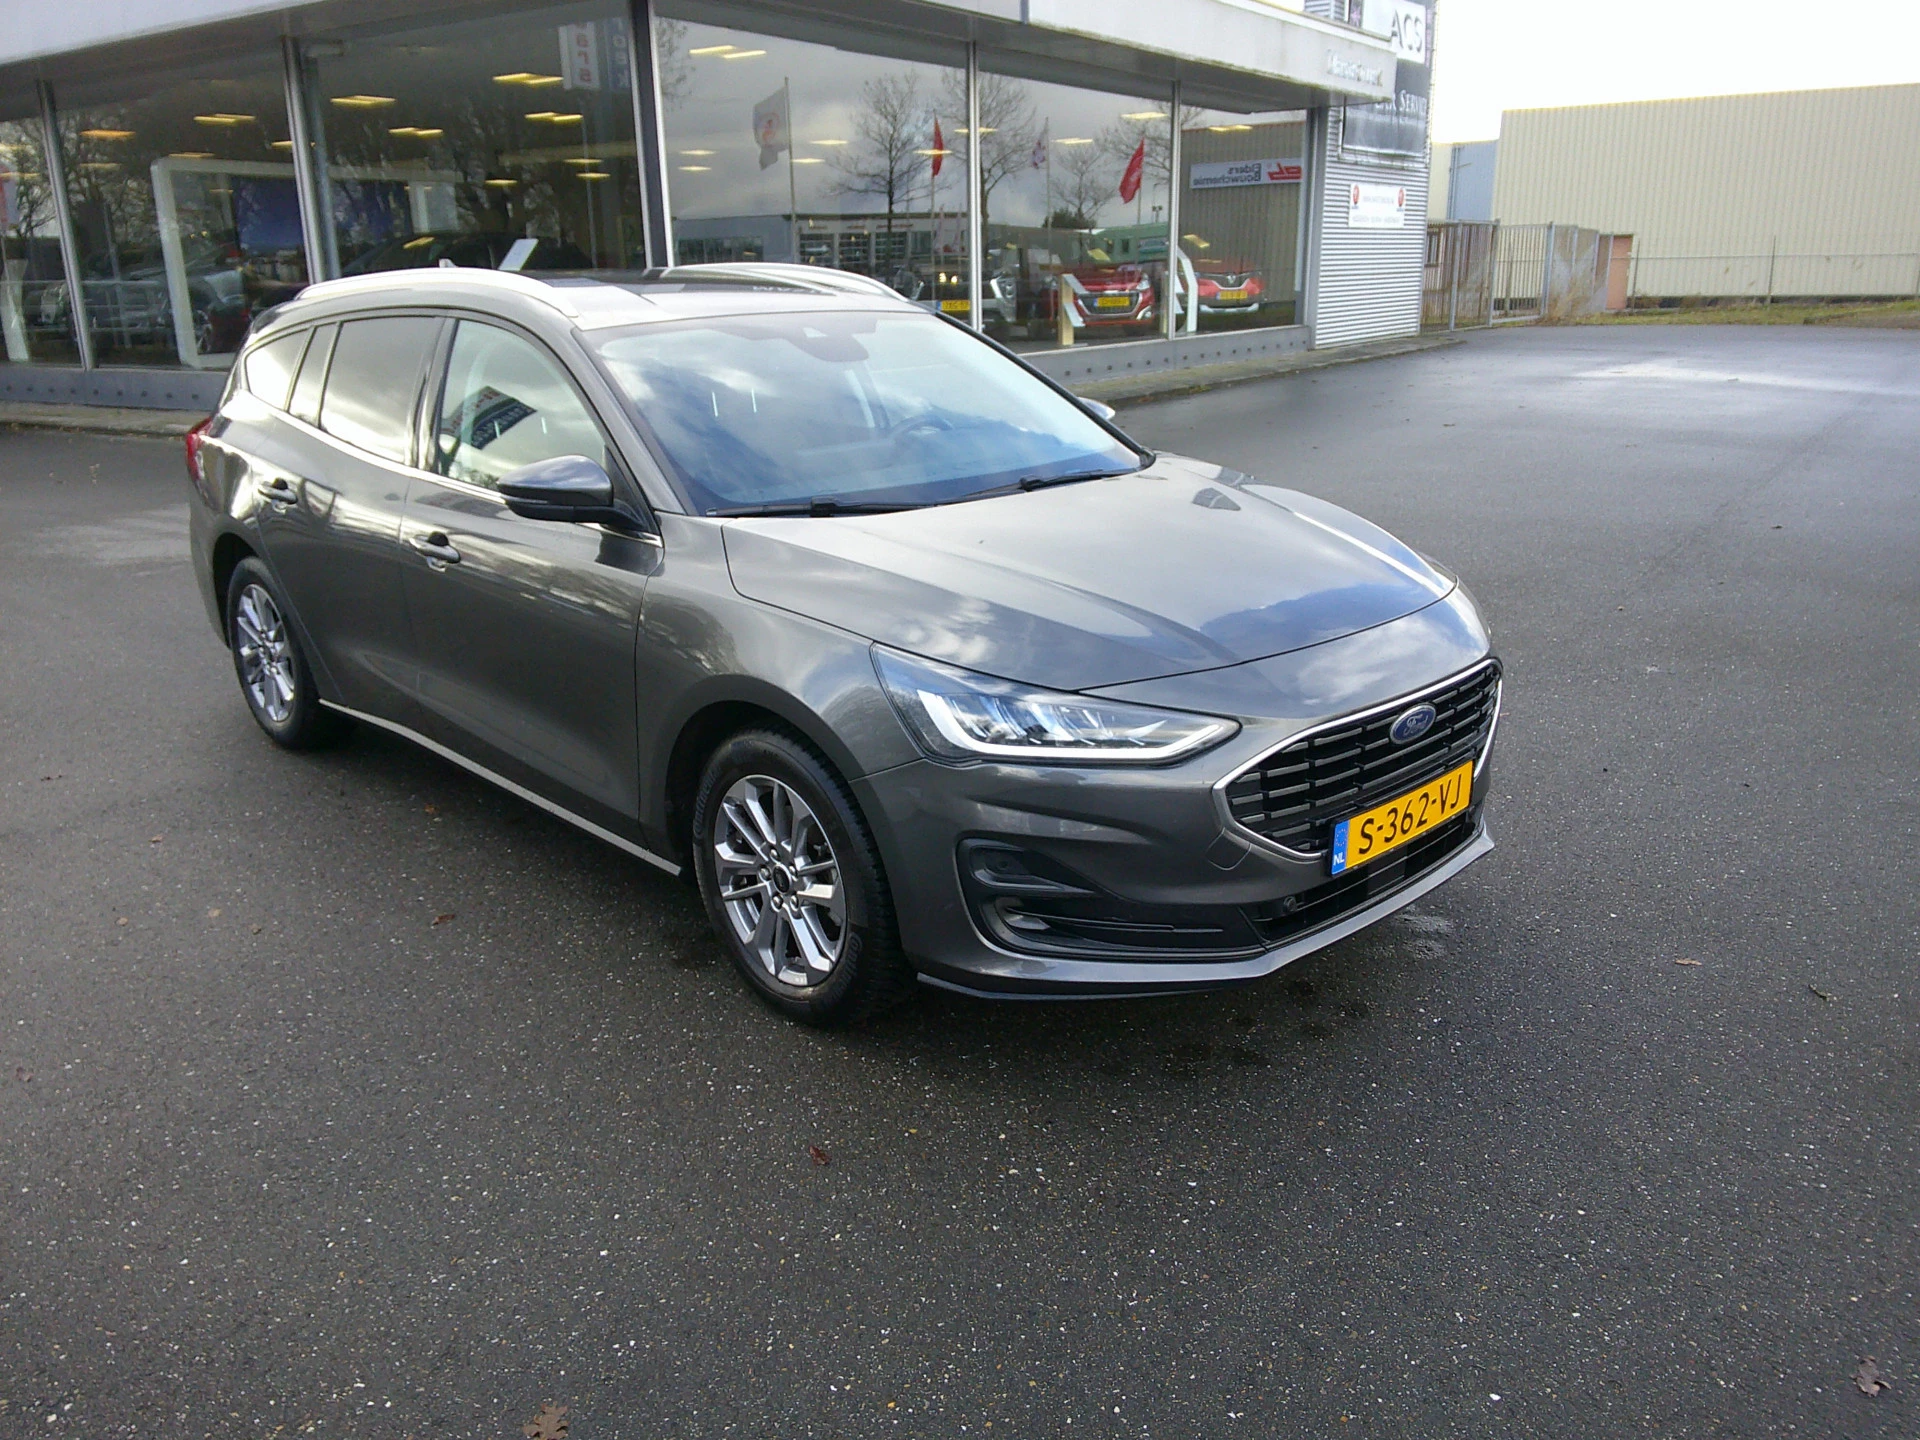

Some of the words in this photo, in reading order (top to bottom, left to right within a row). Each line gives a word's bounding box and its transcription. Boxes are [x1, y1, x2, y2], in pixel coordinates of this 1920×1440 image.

[1391, 8, 1423, 53] ACS
[1359, 774, 1462, 855] S-362-VJ
[1333, 852, 1345, 866] NL
